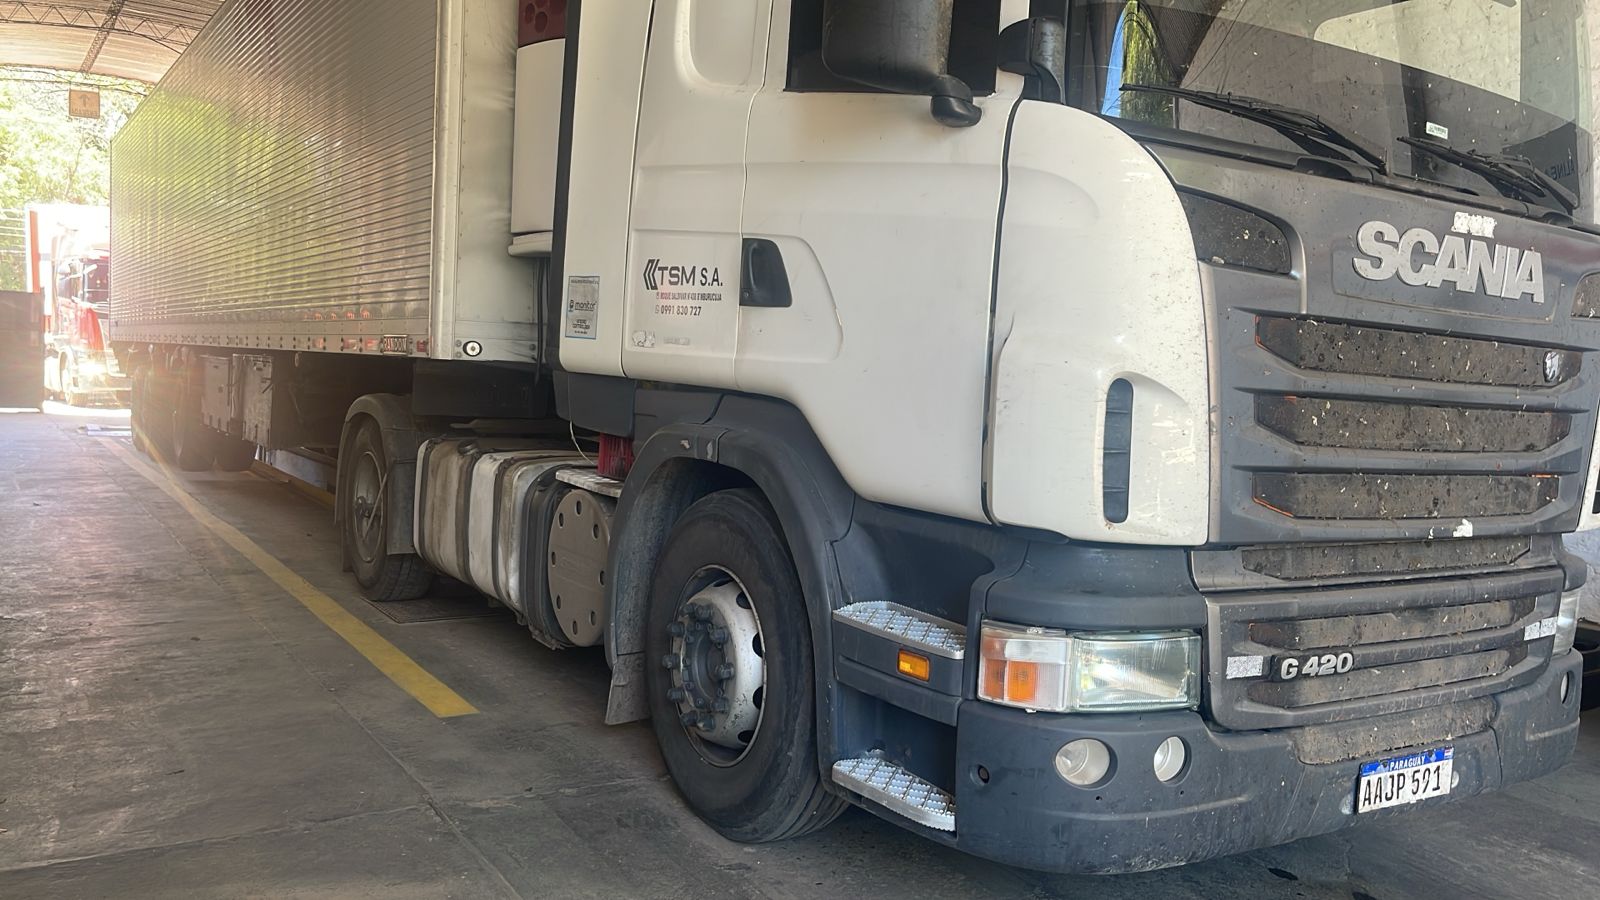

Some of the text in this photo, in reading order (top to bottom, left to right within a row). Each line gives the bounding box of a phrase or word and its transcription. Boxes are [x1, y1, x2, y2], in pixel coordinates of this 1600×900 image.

[1353, 220, 1544, 303] SCANIA
[658, 265, 723, 286] TSM S.A.
[660, 305, 675, 315] 0991
[690, 306, 702, 316] 727
[1281, 652, 1353, 680] G 420
[1389, 755, 1426, 771] PARAGUAY
[1362, 765, 1441, 807] AAJP 591
